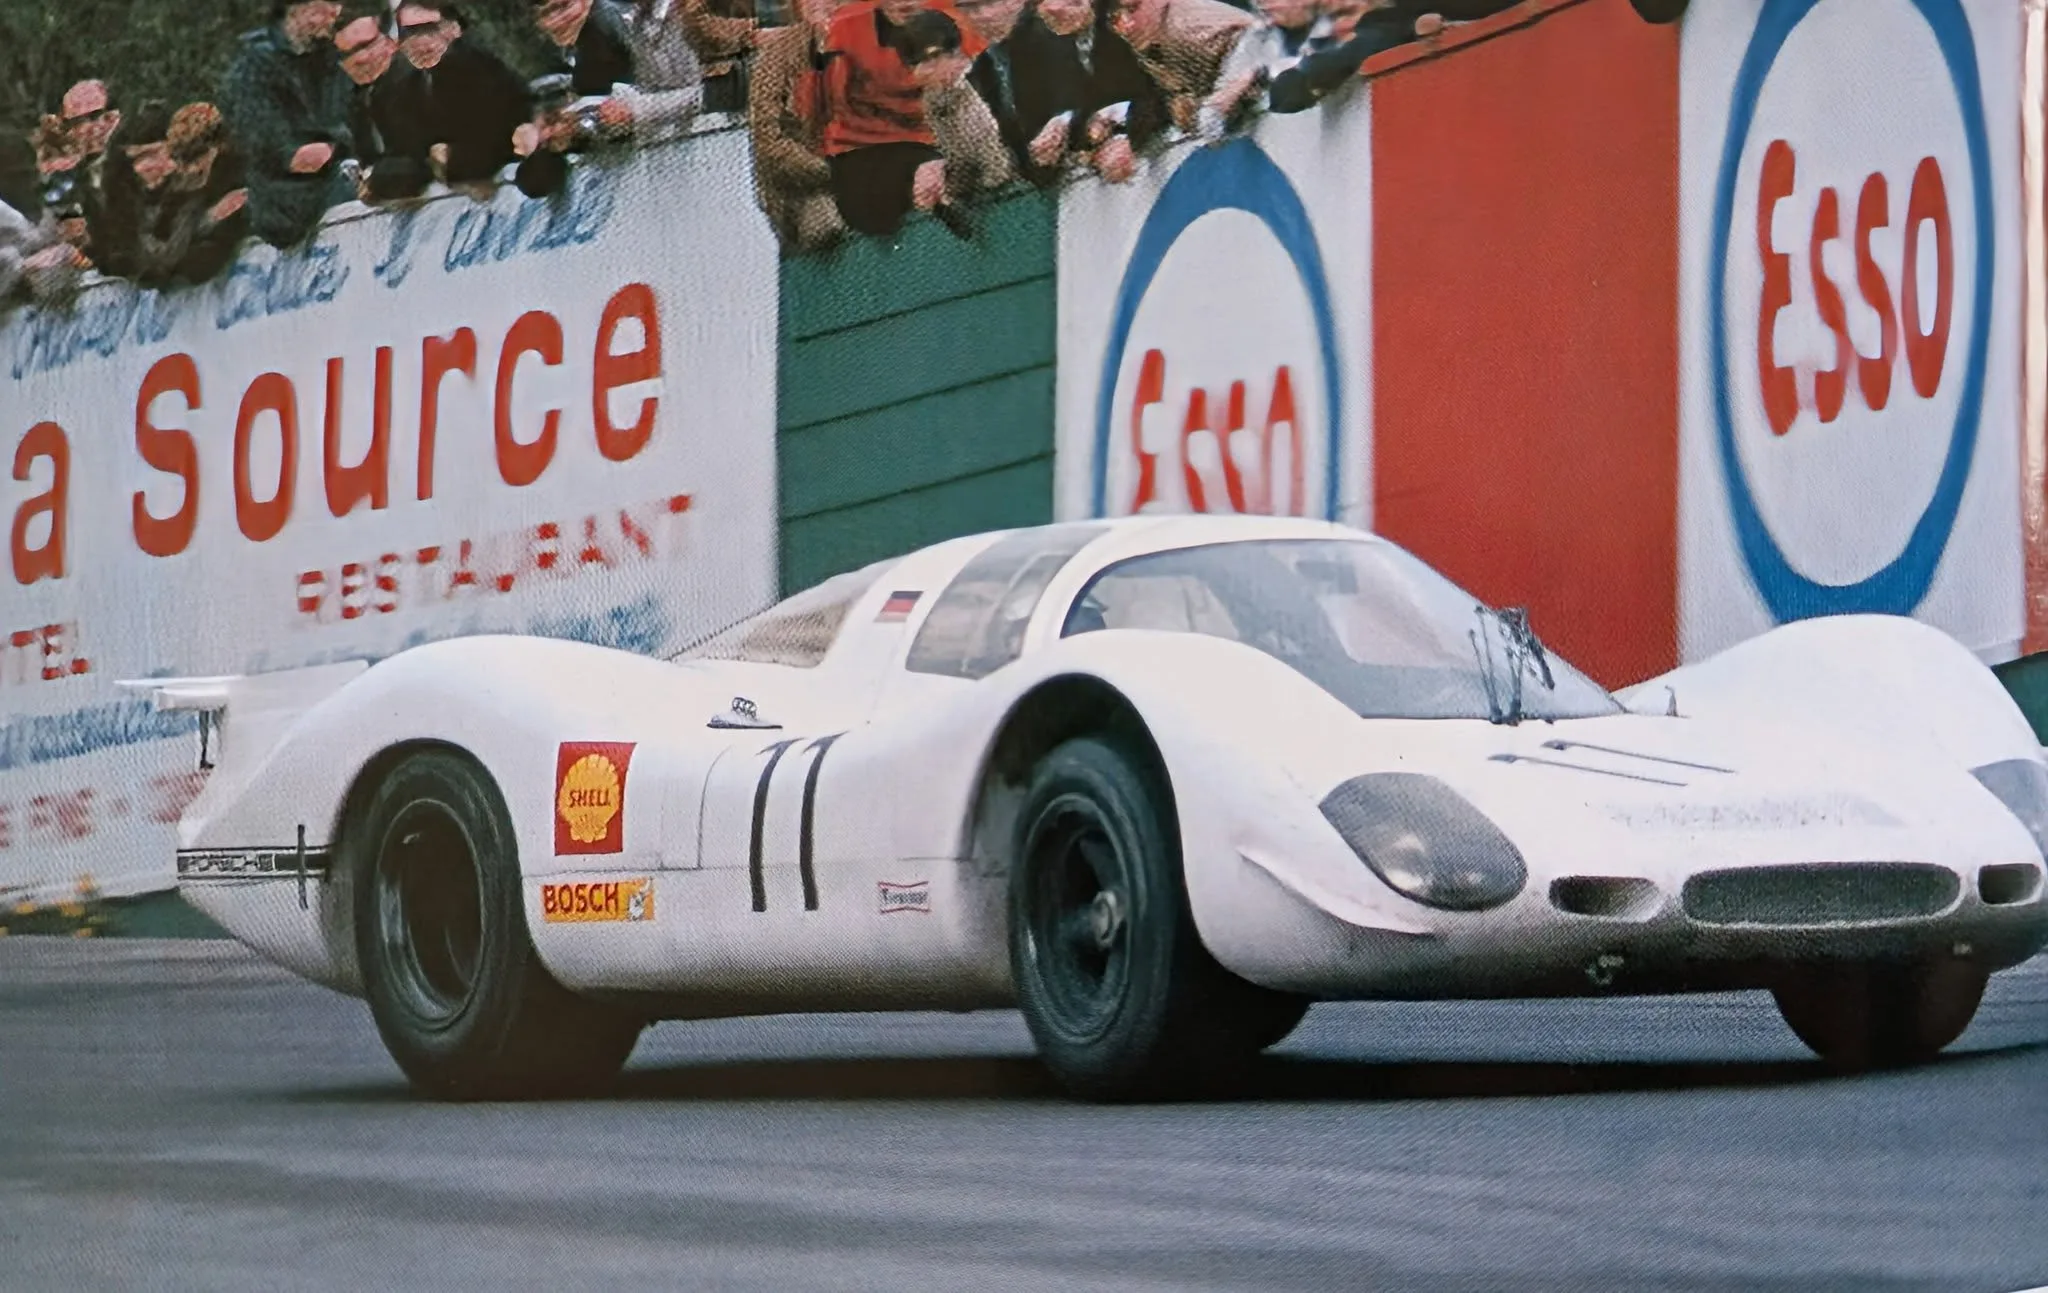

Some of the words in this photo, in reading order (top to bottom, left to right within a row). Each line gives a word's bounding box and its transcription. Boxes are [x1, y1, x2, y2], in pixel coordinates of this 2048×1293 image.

[132, 283, 662, 557] Source
[569, 788, 611, 808] SHELL
[750, 730, 850, 912] 11
[543, 883, 619, 914] BOSCH
